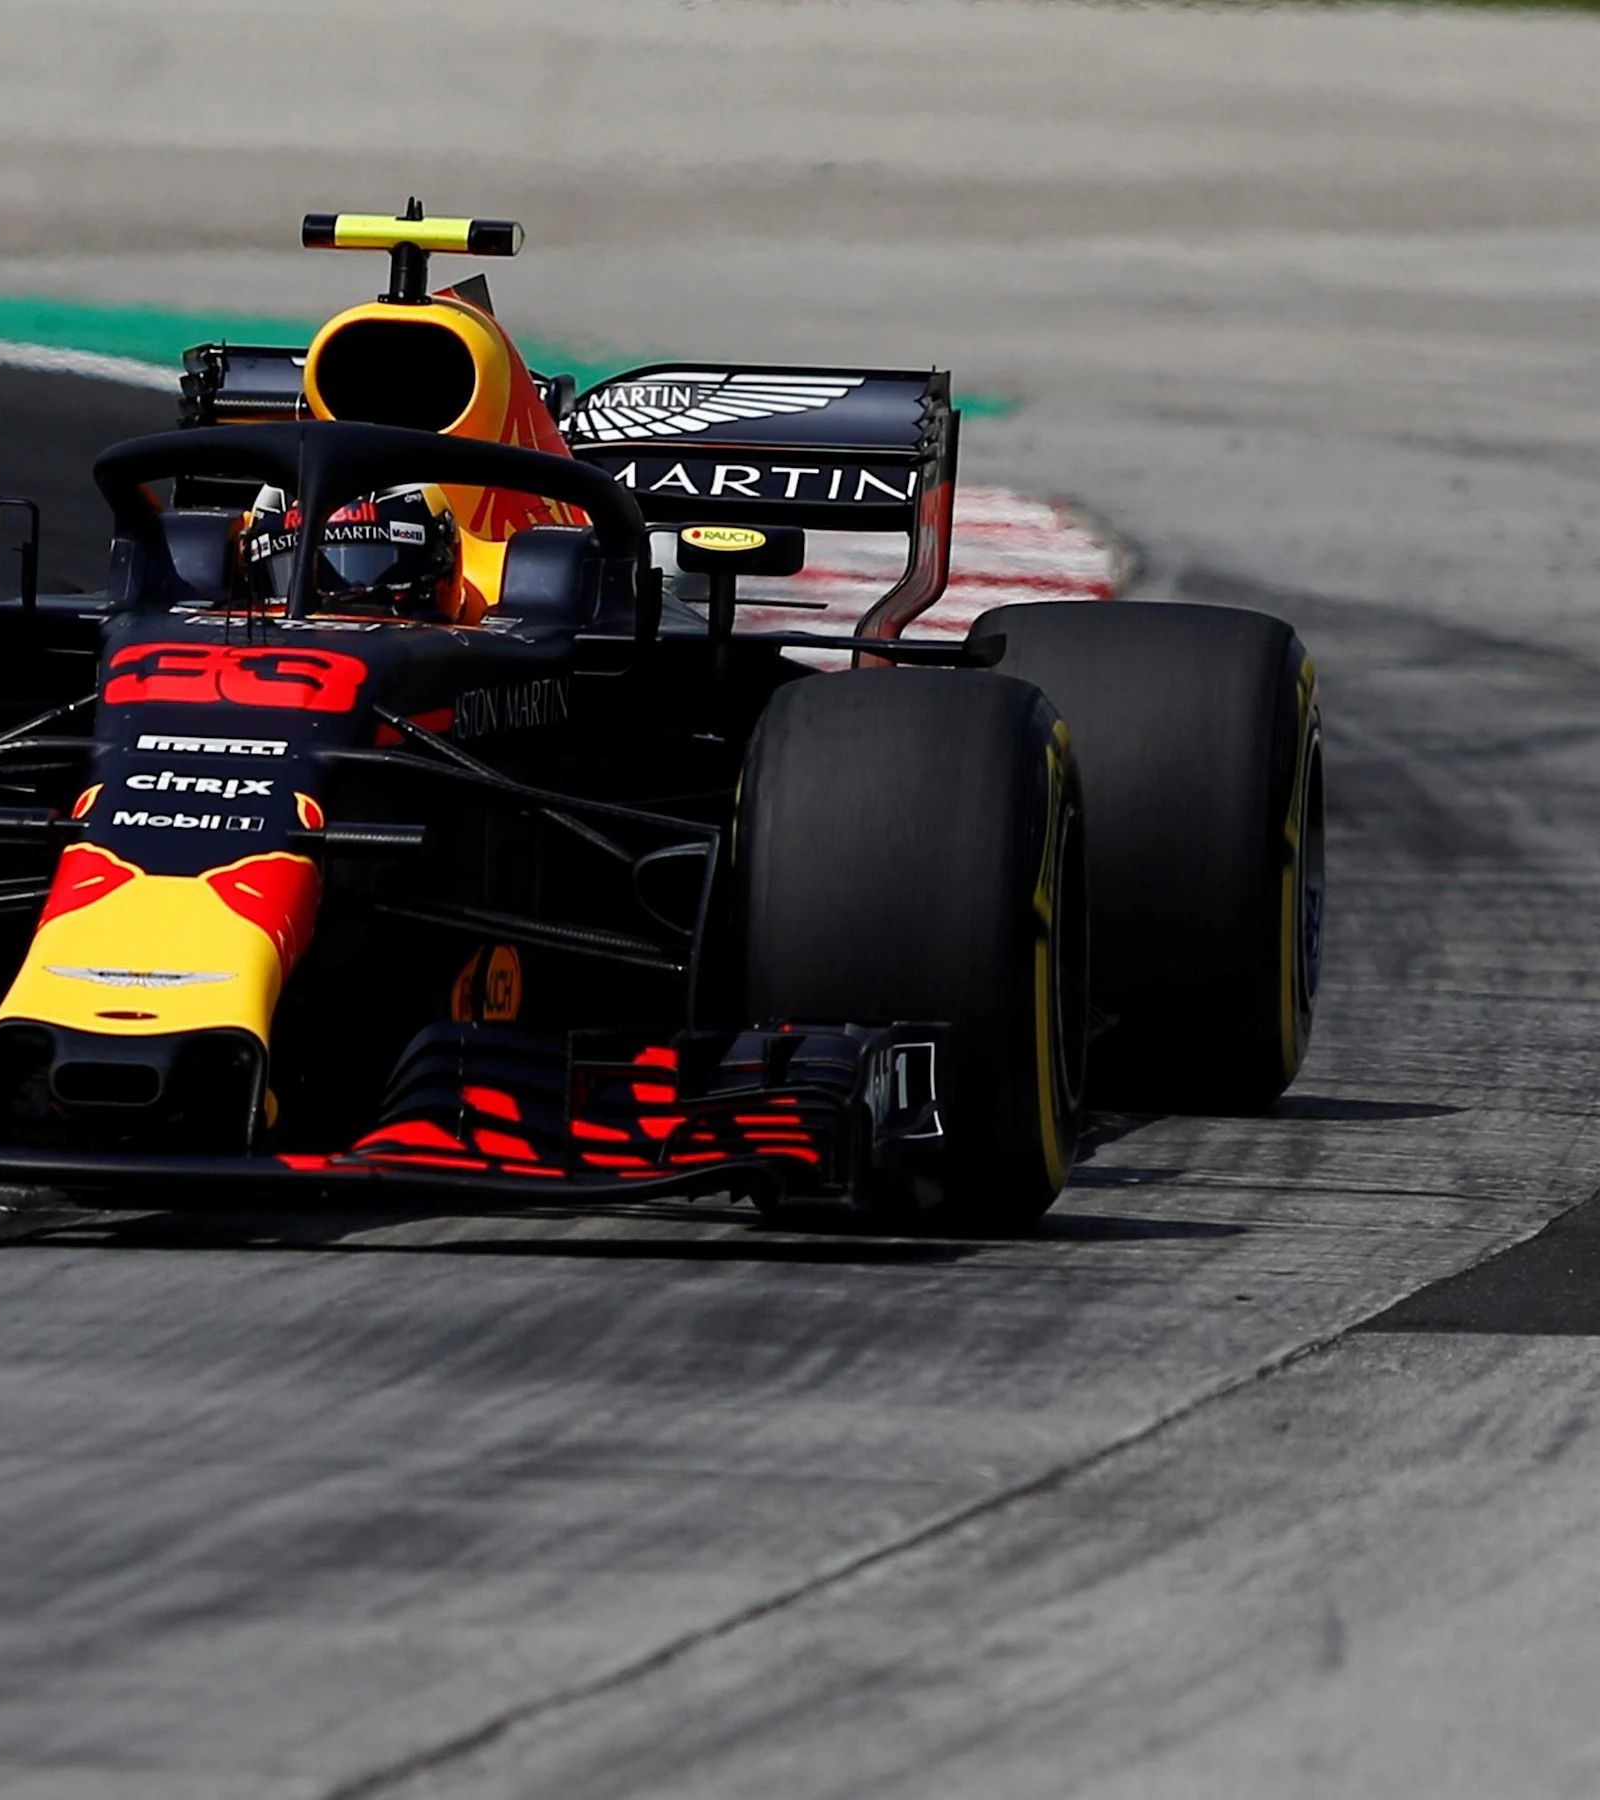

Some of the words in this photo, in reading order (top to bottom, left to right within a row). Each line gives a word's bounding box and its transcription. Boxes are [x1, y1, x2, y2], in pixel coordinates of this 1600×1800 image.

[587, 386, 692, 409] MARTIN
[324, 526, 390, 541] MARTIN
[703, 530, 755, 543] RAUCH
[102, 642, 369, 713] 33
[452, 687, 499, 741] ASTON
[504, 676, 570, 732] MARTIN
[136, 734, 289, 756] PIRELLI
[112, 810, 221, 830] Mobil
